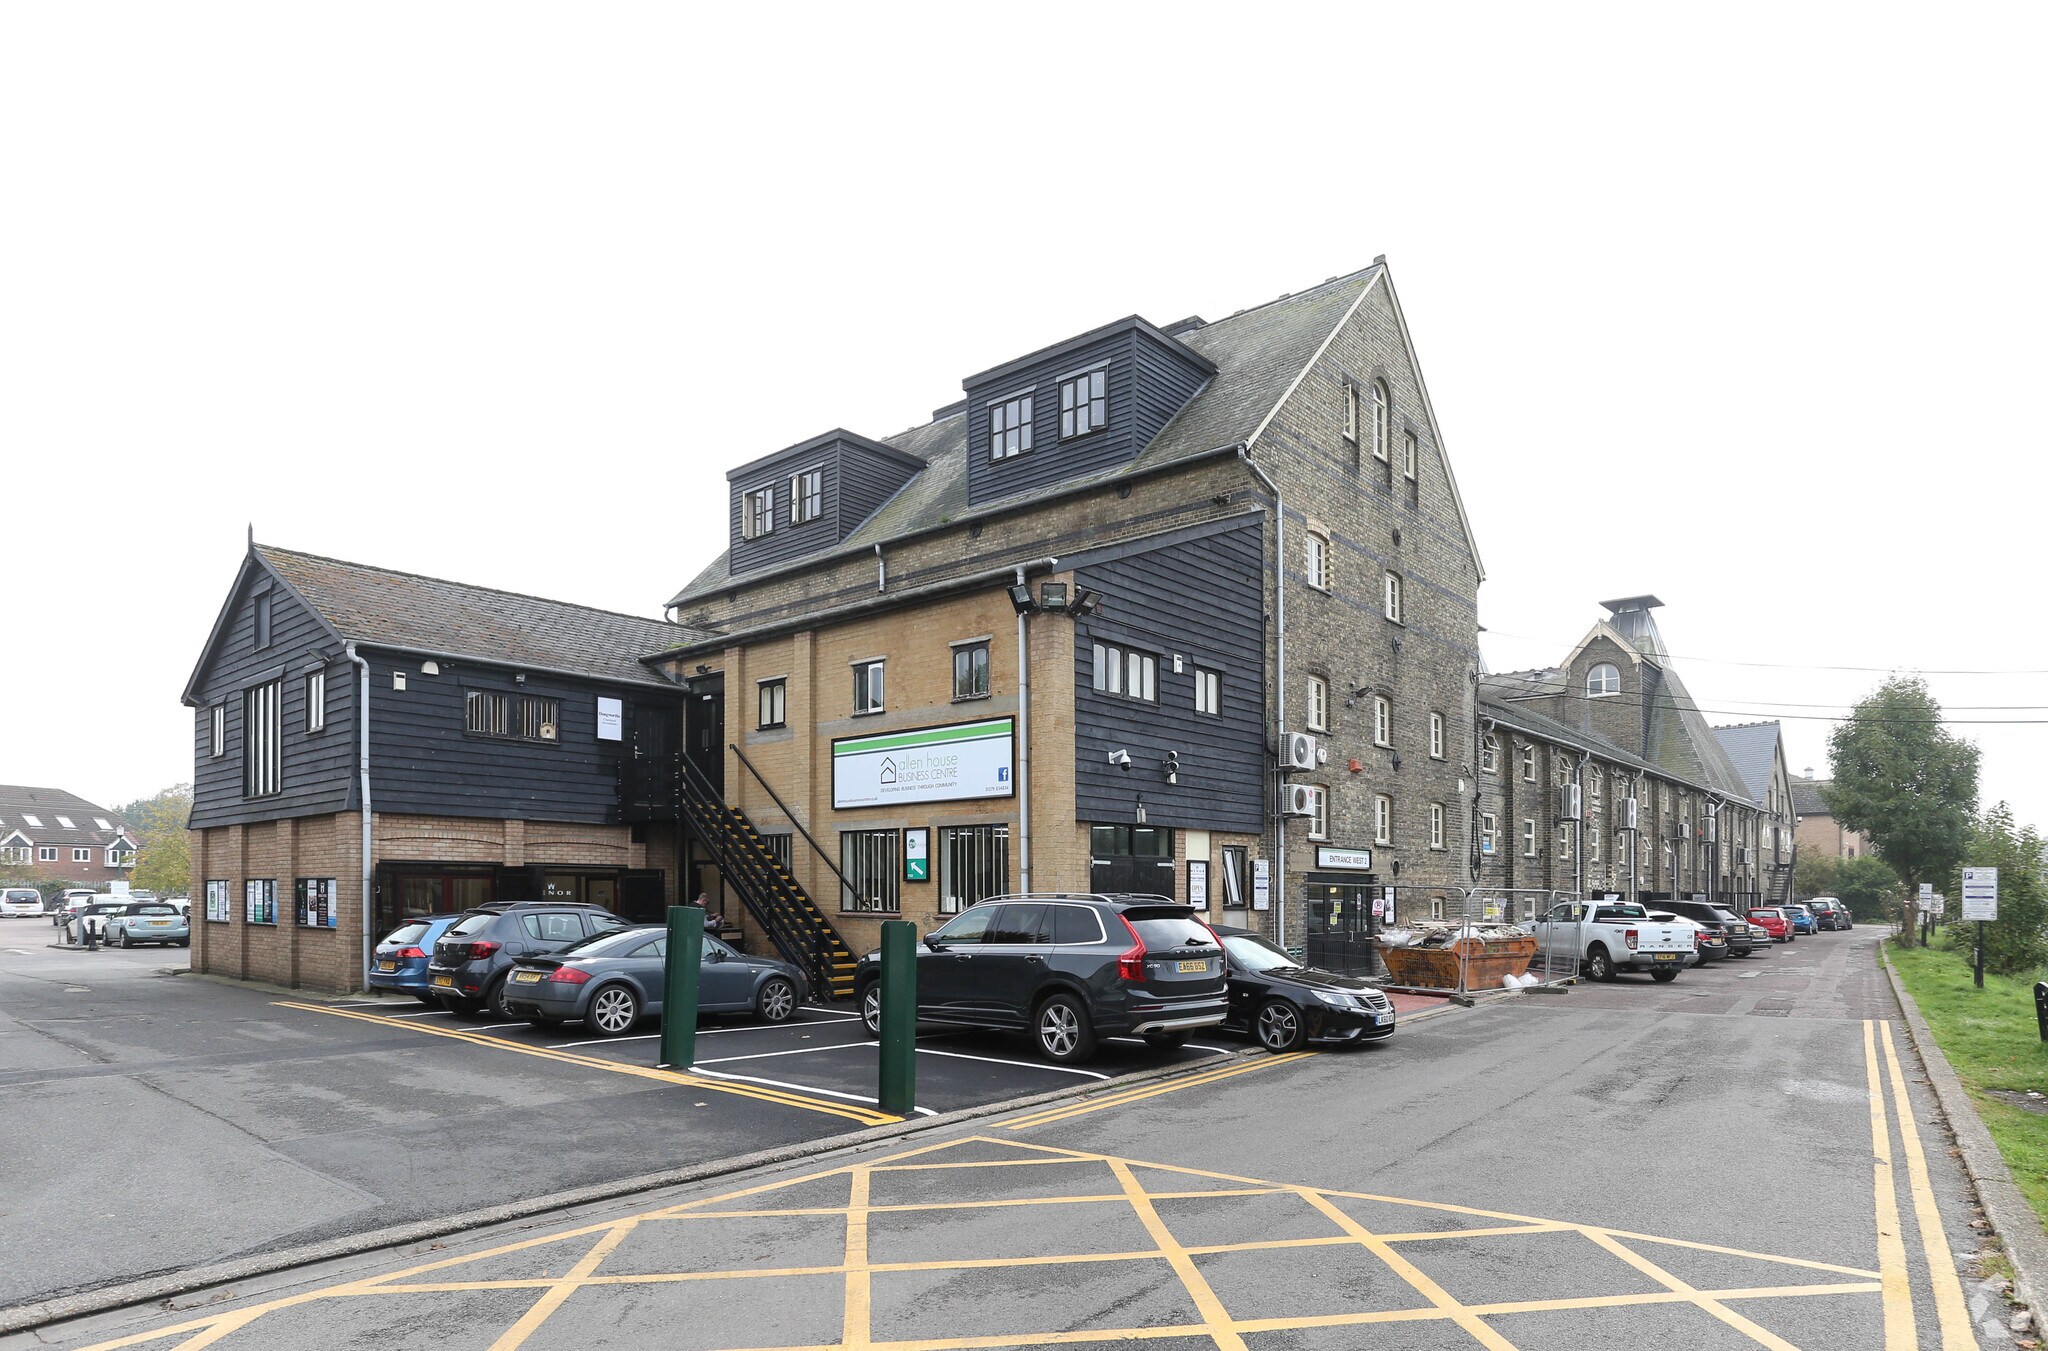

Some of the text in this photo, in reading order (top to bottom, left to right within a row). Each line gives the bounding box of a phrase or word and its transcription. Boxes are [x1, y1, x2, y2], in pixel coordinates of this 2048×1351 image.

[898, 751, 958, 771] allen house
[898, 767, 958, 783] BUSINESS CENTRE
[934, 781, 958, 789] COMMUNITY
[1329, 855, 1352, 864] ENTRANCE
[1179, 961, 1205, 971] EA66 GSZ
